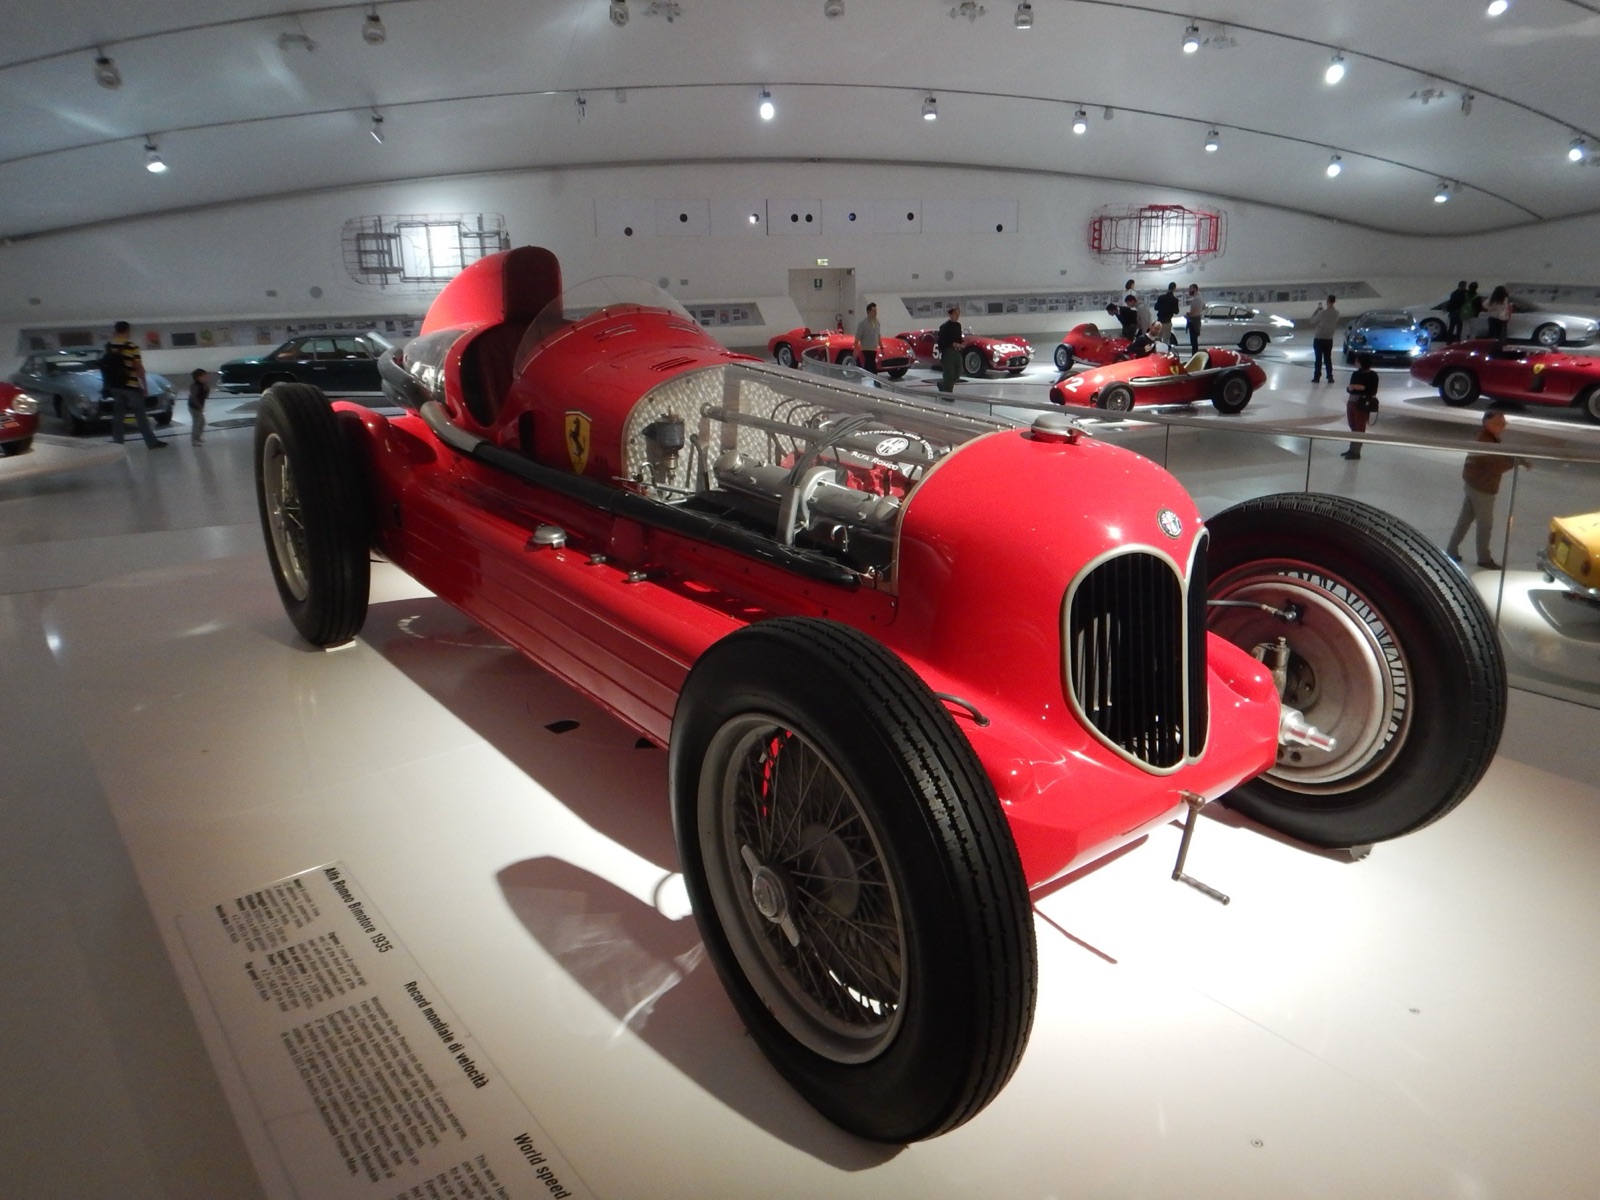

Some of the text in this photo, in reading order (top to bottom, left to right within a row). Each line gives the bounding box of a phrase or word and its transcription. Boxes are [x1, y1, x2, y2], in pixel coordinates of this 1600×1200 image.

[851, 451, 899, 471] ALFA ROMEO
[323, 867, 394, 953] Alfa Romeo Bimotore 1935
[404, 980, 490, 1090] Record mondiale di velocità
[514, 1132, 572, 1200] World speed
